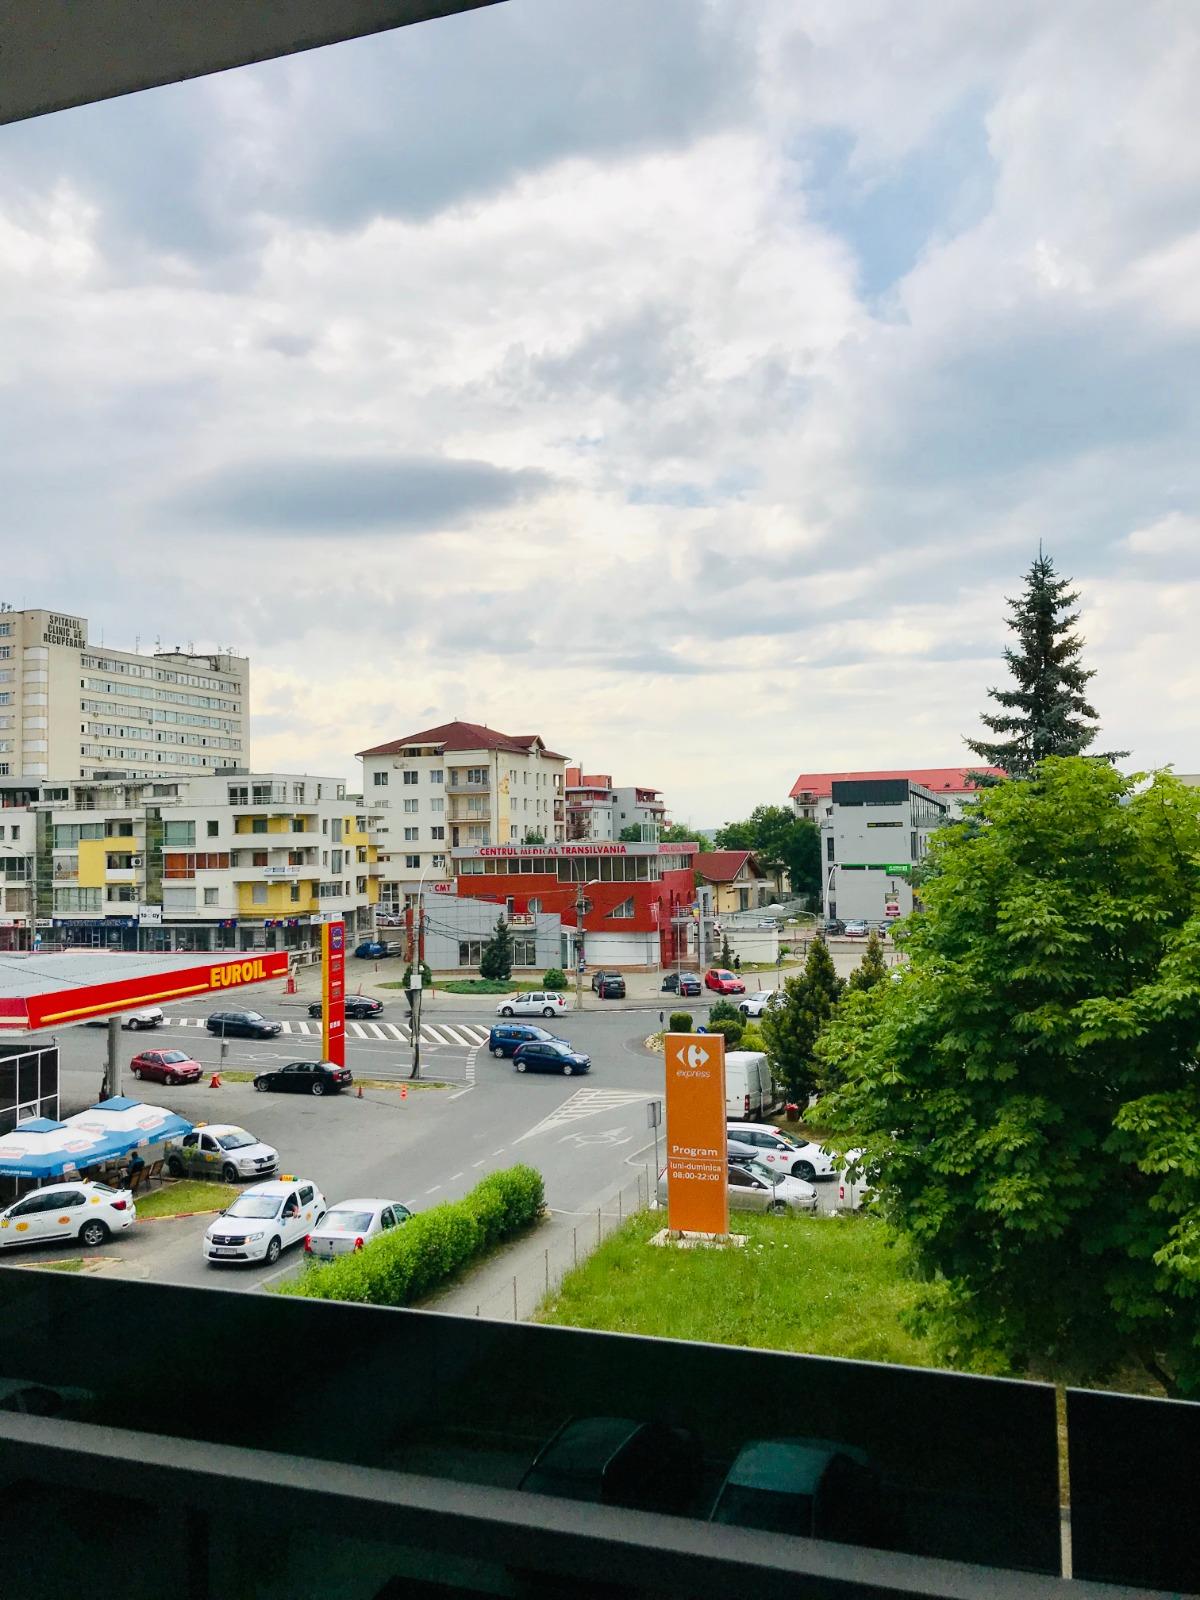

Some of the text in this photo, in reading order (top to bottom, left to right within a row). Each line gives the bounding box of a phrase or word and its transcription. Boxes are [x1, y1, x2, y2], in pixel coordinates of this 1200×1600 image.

[49, 615, 80, 630] SPITALUL
[47, 624, 82, 640] CLINIC DE
[43, 633, 86, 650] RECUPERARE
[480, 847, 518, 856] CENTRUL
[561, 845, 627, 855] TRANSILVANIA
[434, 884, 451, 892] CMT
[210, 959, 267, 988] EUROIL
[676, 1071, 711, 1079] express
[672, 1145, 718, 1157] Program
[672, 1171, 720, 1181] 08:00-22:00
